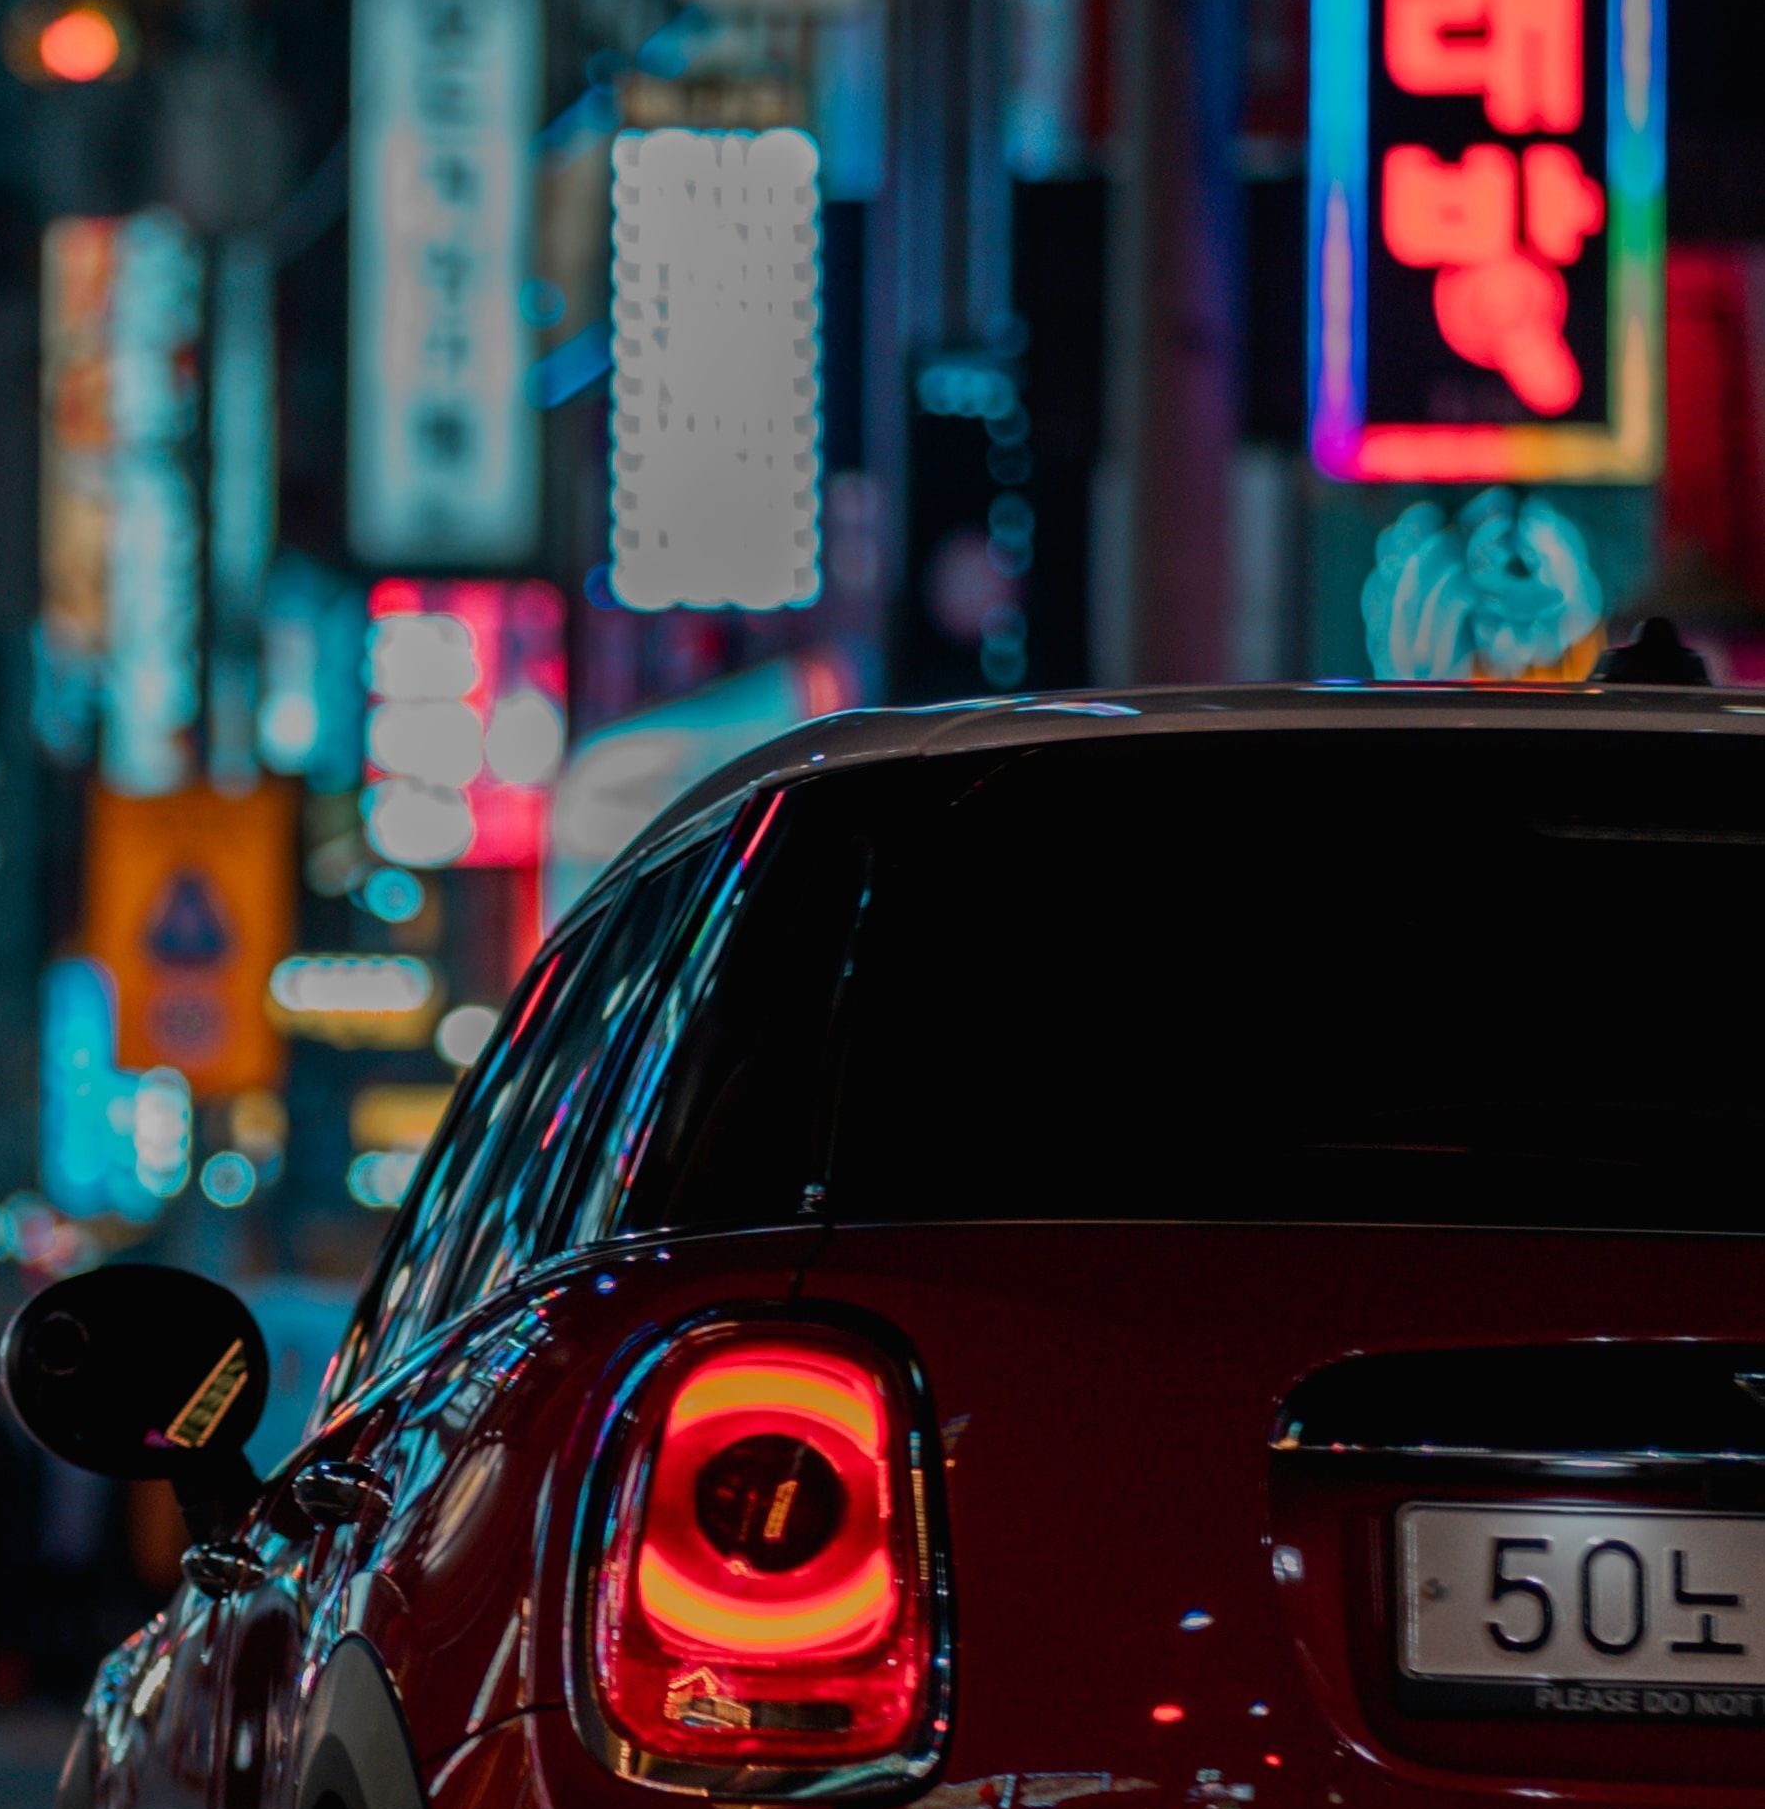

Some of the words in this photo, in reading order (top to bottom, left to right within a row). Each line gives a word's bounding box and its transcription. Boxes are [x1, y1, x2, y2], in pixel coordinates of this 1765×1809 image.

[1484, 1536, 1746, 1656] 50노
[1534, 1686, 1641, 1713] PLEASE
[1642, 1690, 1691, 1716] DO
[1693, 1692, 1755, 1718] NOT
